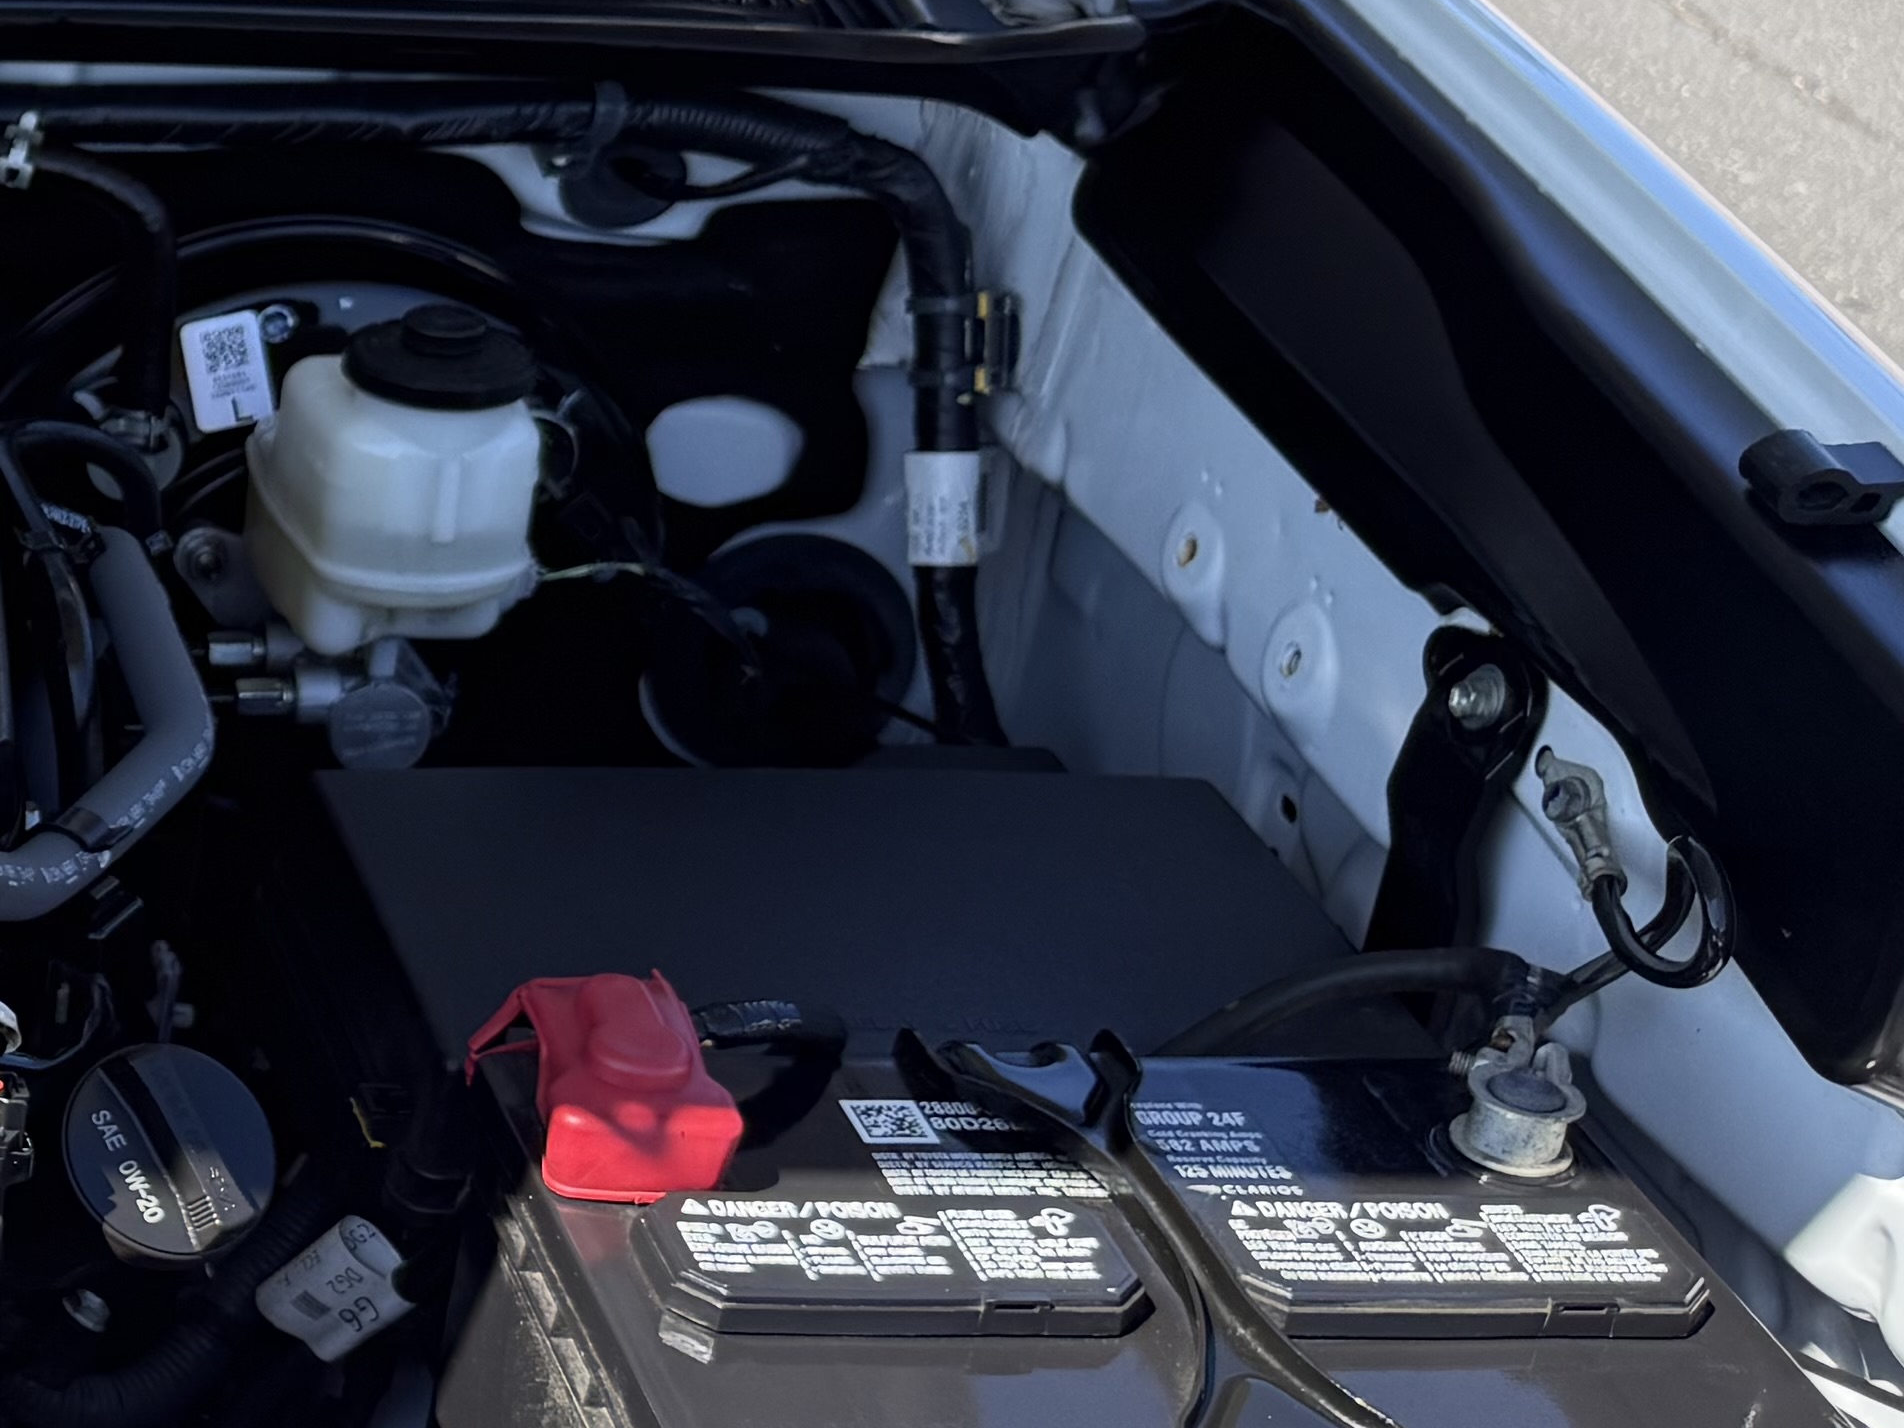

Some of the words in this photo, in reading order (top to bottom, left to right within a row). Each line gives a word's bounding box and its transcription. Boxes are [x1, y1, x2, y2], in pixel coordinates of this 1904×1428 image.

[1134, 1110, 1203, 1126] GROUP
[1206, 1111, 1246, 1127] 24F
[1199, 1139, 1261, 1153] AMPS
[91, 1109, 129, 1152] SAE
[118, 1159, 166, 1224] 0W-20
[1208, 1164, 1293, 1180] MINUTES
[708, 1198, 800, 1219] DANGER
[813, 1201, 903, 1219] POISON
[1255, 1200, 1350, 1220] DANGER
[1363, 1201, 1451, 1220] POISON
[338, 1296, 380, 1333] G6
